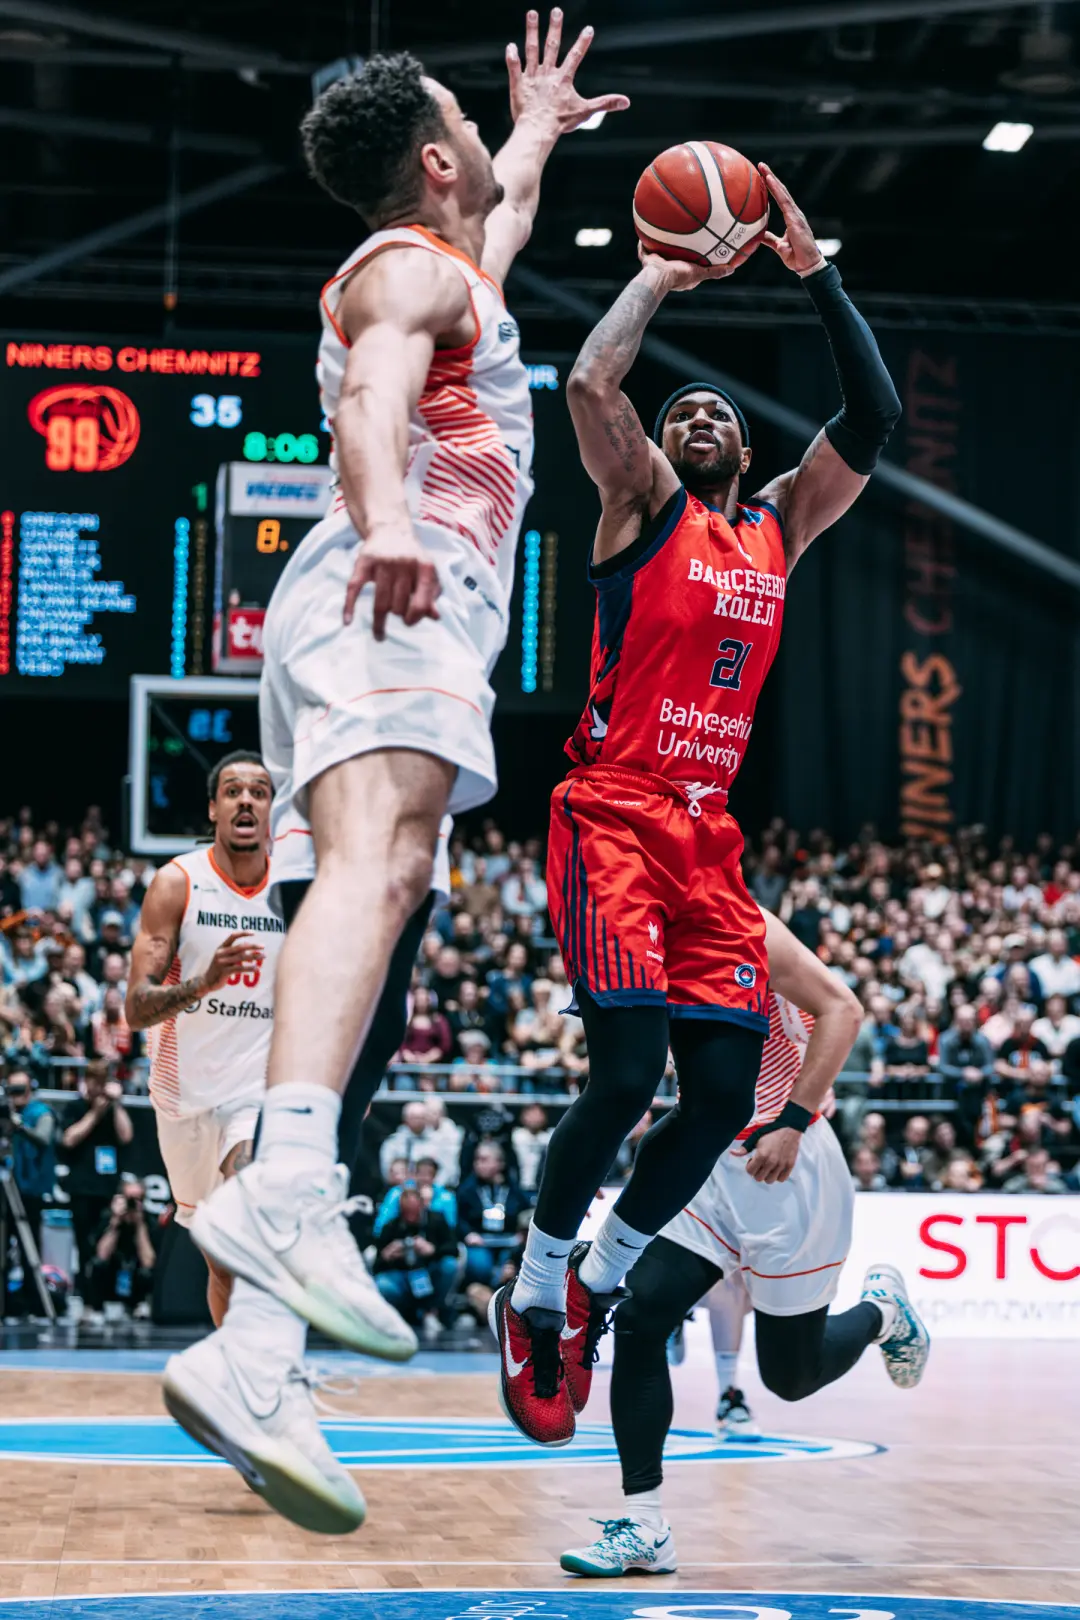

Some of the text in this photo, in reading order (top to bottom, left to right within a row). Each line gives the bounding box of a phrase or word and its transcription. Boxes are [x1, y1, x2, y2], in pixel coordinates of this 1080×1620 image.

[6, 342, 261, 377] NINERS CHEMNITZ
[713, 592, 776, 626] KOLEJİ
[709, 638, 753, 691] 21
[657, 729, 741, 775] University
[197, 910, 238, 930] NINERS
